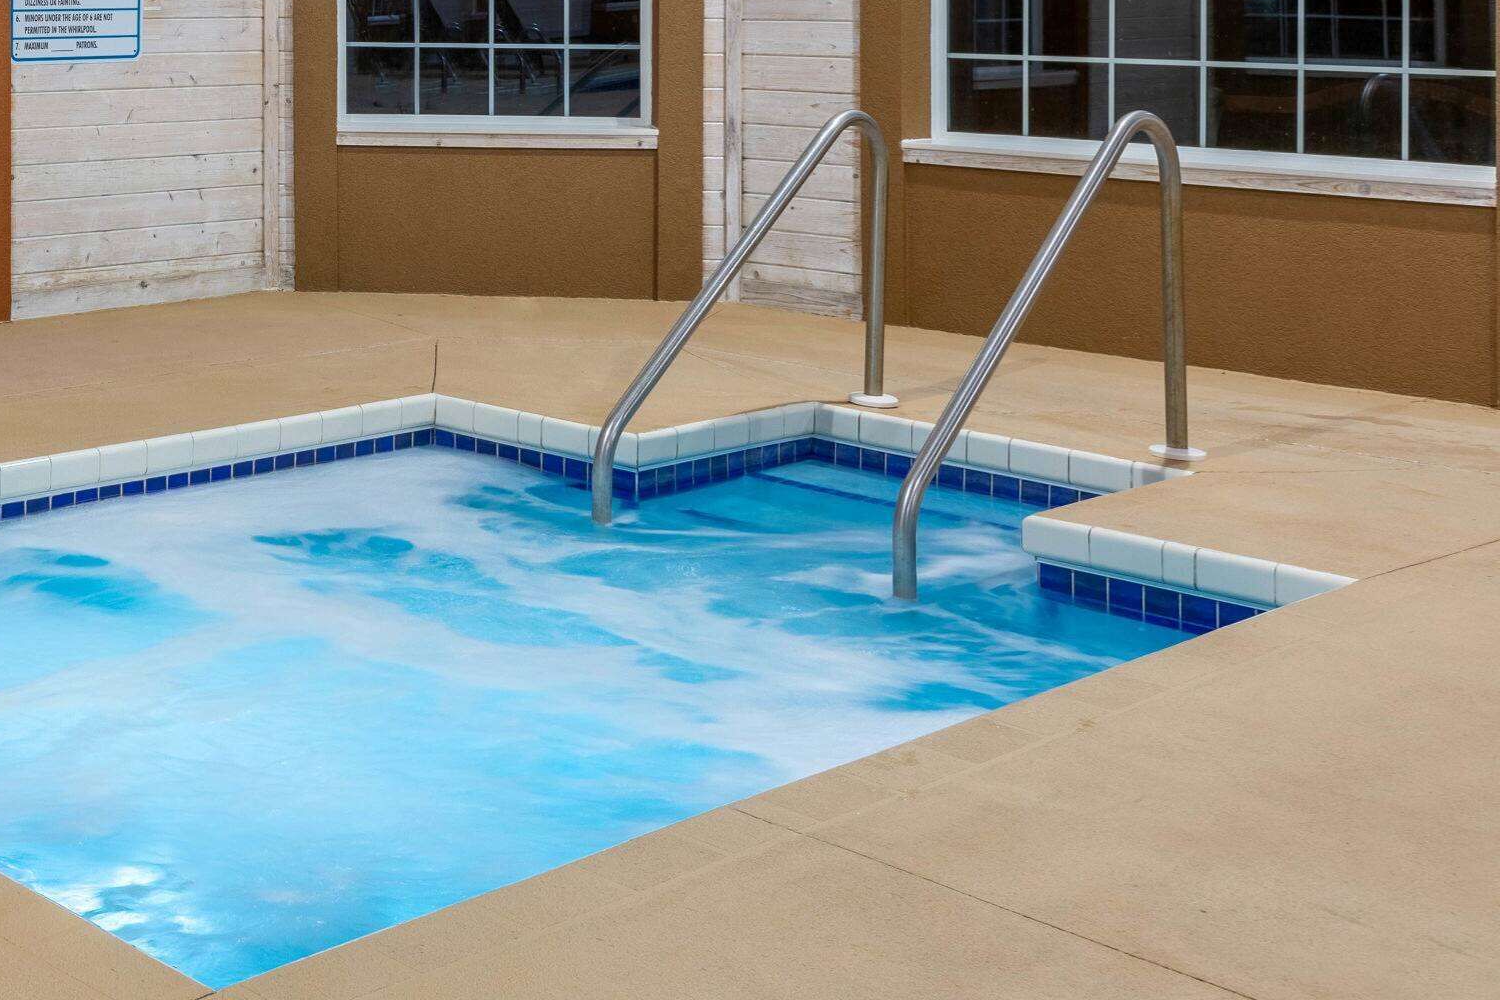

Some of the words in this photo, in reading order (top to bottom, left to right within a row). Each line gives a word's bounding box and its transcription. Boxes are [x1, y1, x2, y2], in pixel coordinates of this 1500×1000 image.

[25, 14, 44, 22] MINORS
[45, 14, 61, 22] UNDER
[62, 14, 71, 22] THE
[94, 13, 103, 21] ARE
[104, 13, 113, 21] NOT
[25, 26, 50, 34] PERMITTED
[58, 26, 67, 34] THE
[24, 42, 49, 50] MAXIMUM
